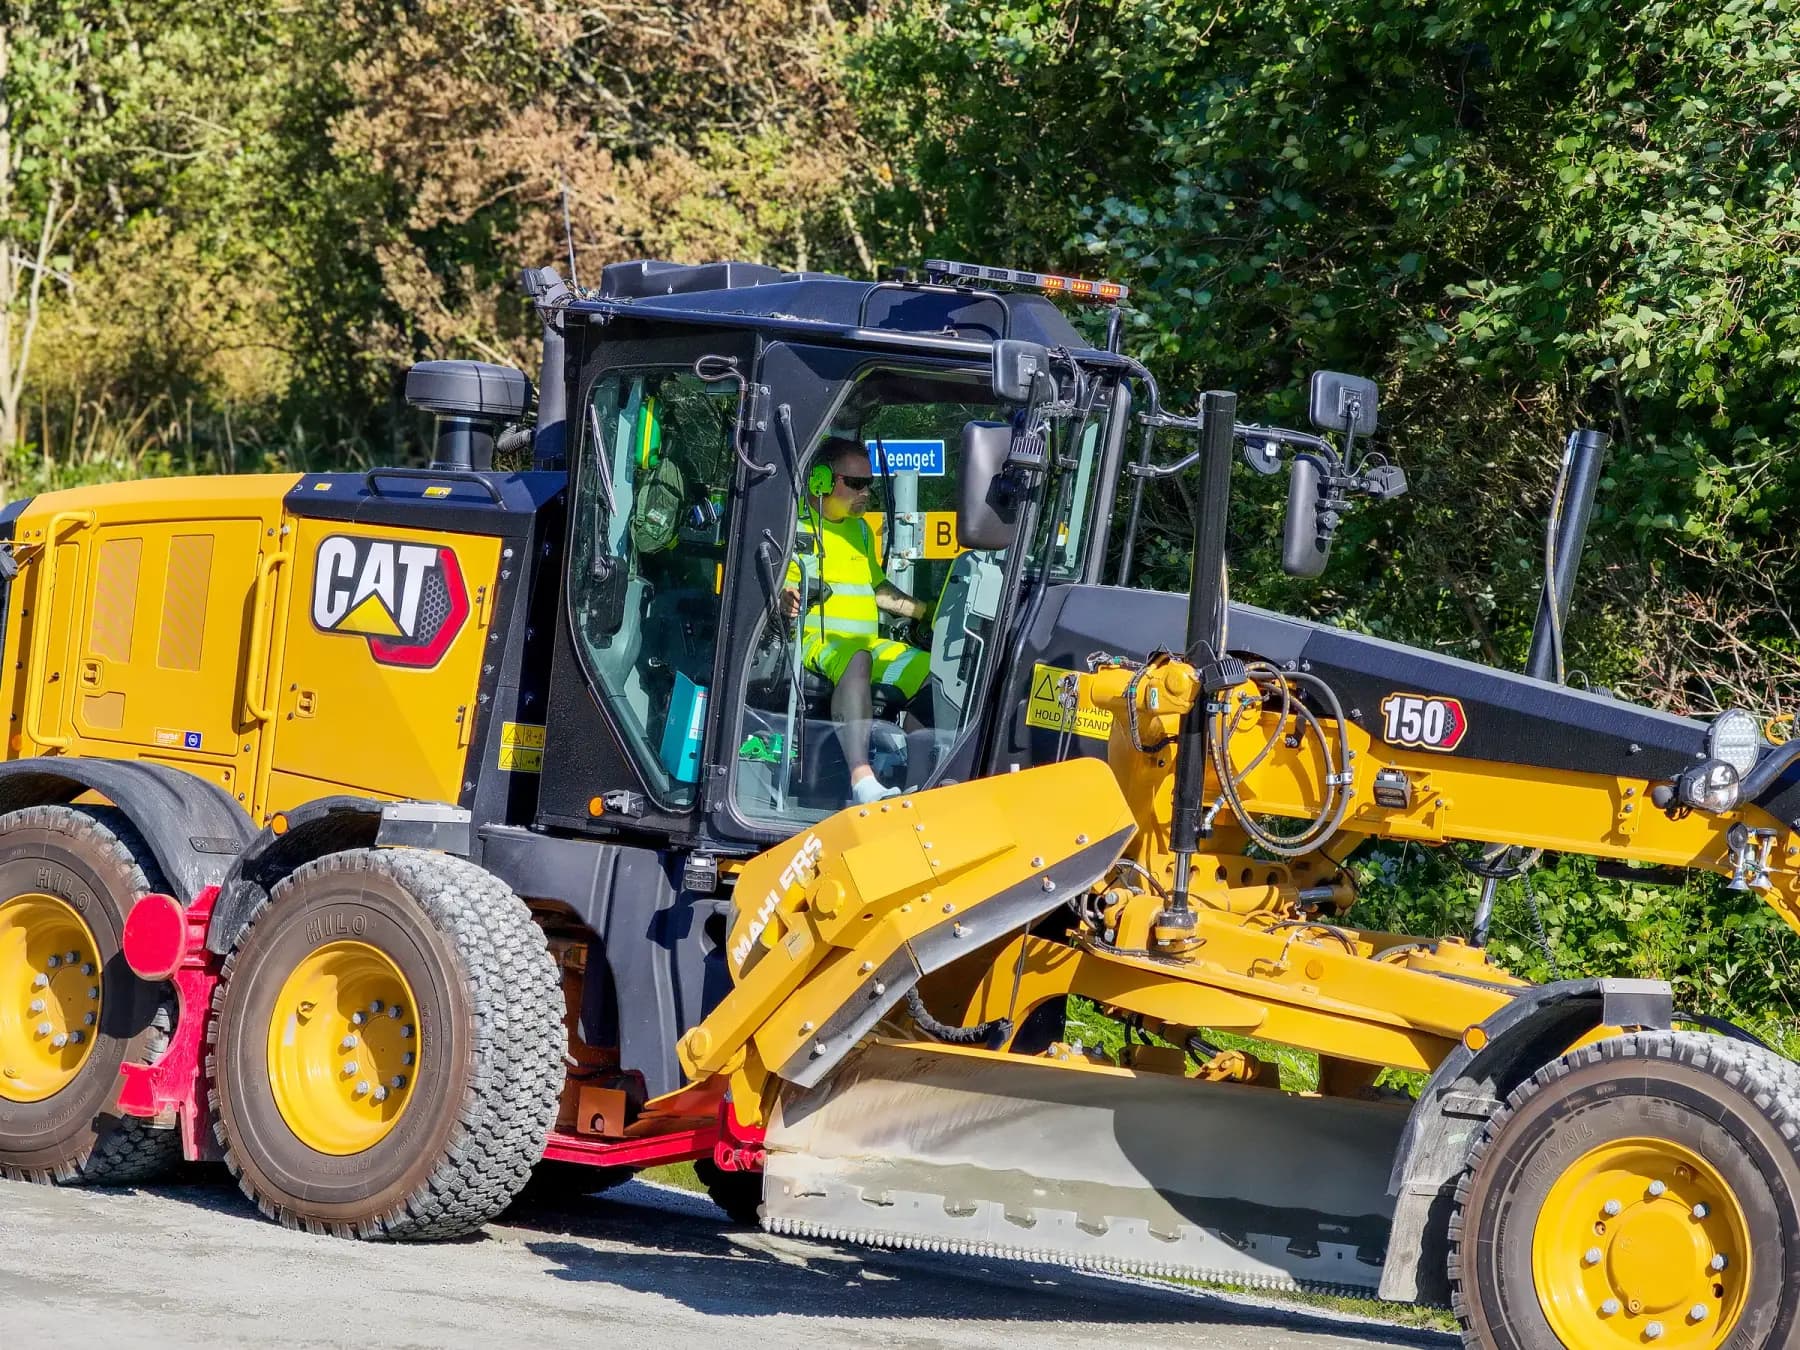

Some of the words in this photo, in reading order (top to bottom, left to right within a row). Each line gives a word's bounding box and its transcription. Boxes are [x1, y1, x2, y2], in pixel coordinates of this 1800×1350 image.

[314, 537, 438, 637] CAT
[1035, 708, 1060, 722] HOLD
[1384, 697, 1445, 744] 150
[35, 866, 90, 912] HILO
[305, 913, 368, 944] HILO
